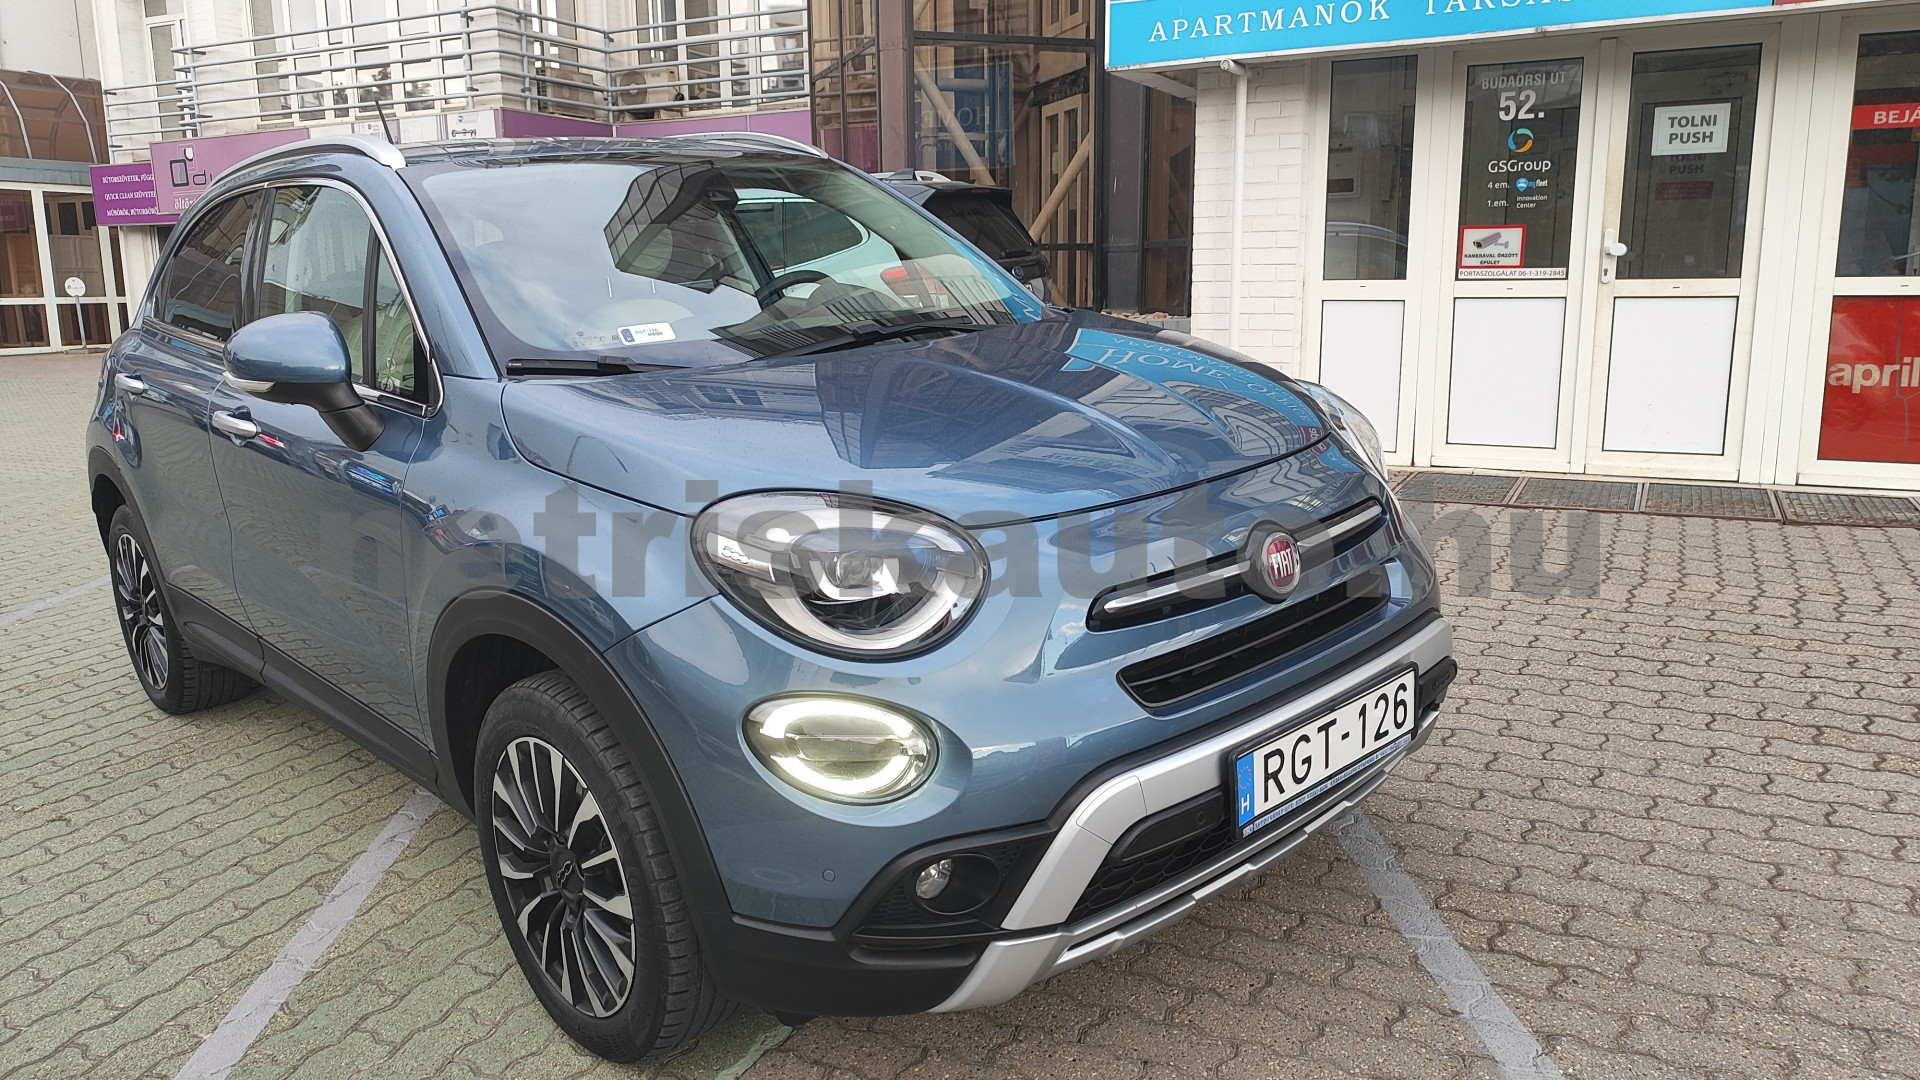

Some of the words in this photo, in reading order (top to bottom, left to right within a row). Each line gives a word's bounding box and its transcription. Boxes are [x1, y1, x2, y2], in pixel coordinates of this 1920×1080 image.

[1148, 0, 1391, 43] APARTMANOK
[1481, 71, 1546, 90] BUDAÖRSI
[1550, 70, 1568, 85] ÚT
[1498, 89, 1545, 121] 52.
[1668, 114, 1718, 129] TOLNI
[1668, 131, 1714, 145] PUSH
[1487, 159, 1552, 173] GSGroup
[1487, 181, 1493, 190] 4
[1459, 268, 1517, 277] PORTASZOLGÁLAT
[1270, 547, 1294, 580] FIAT
[1263, 682, 1408, 803] RGT-126
[1241, 793, 1250, 815] H
